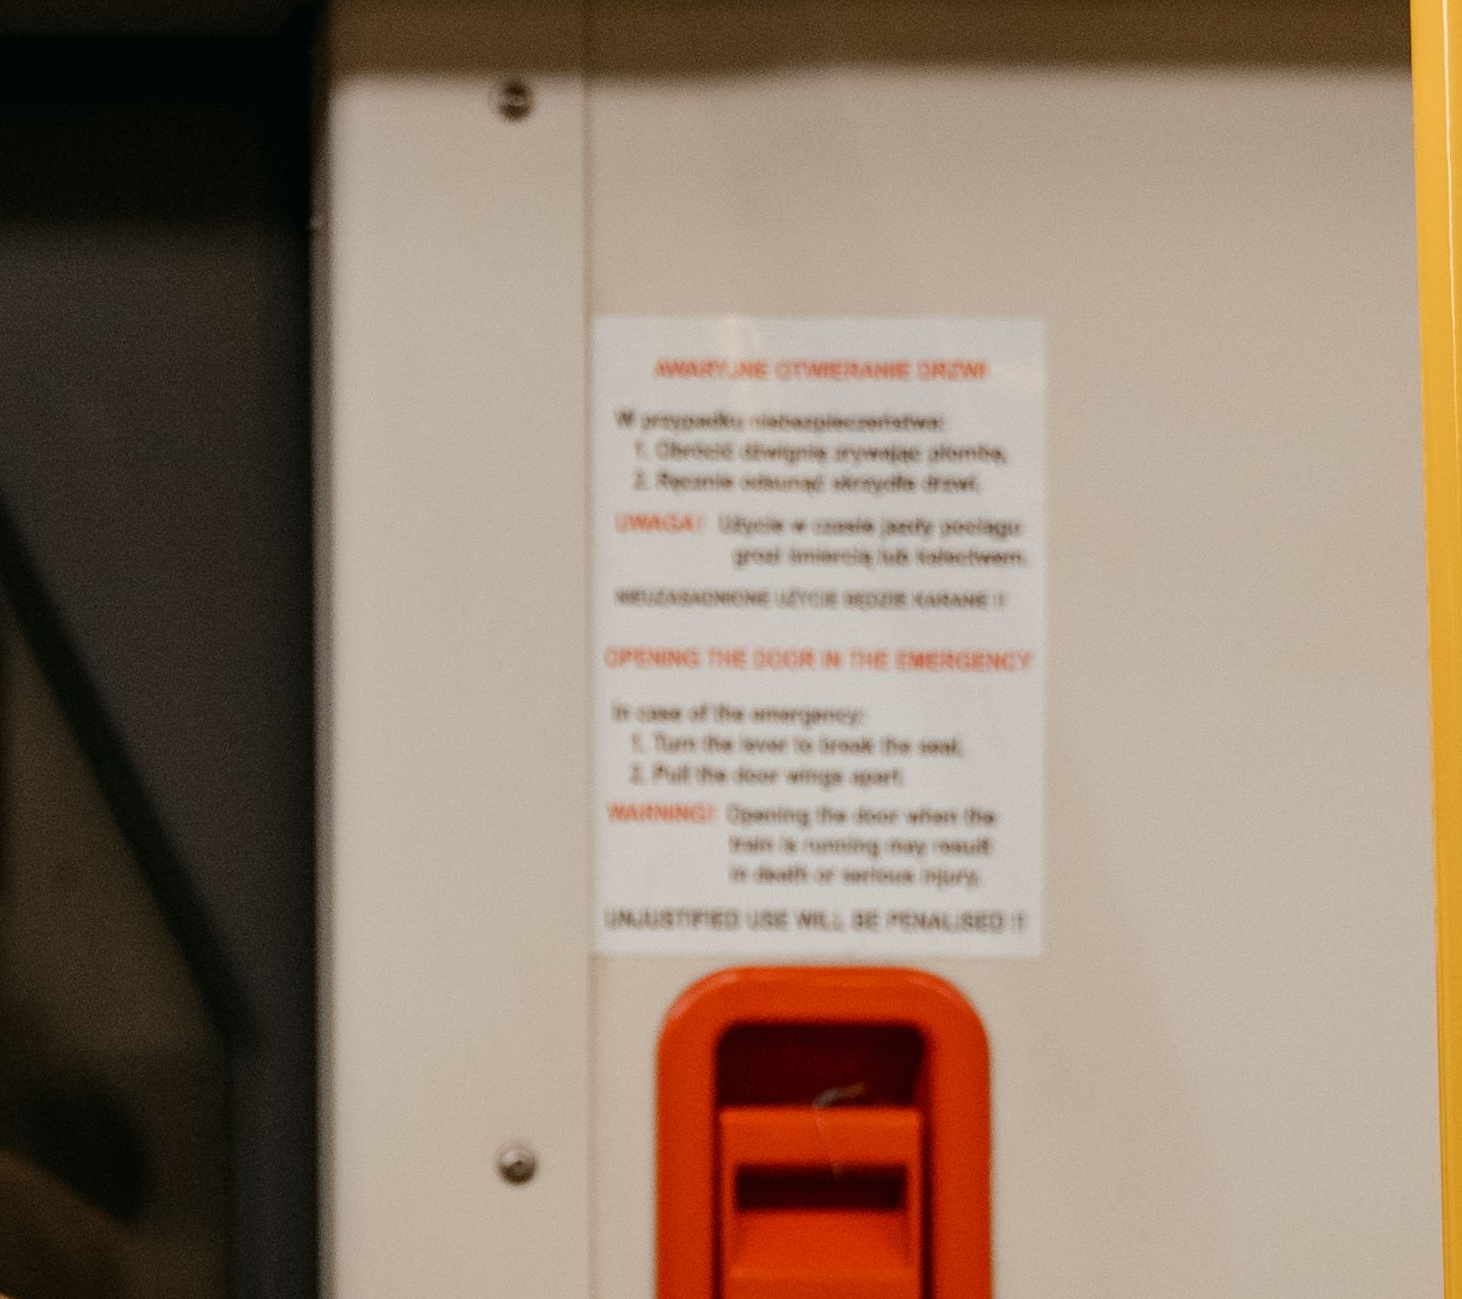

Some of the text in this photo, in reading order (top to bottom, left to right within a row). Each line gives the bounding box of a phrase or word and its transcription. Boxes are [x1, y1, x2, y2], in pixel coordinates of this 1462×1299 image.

[604, 646, 700, 670] OPENING
[754, 646, 814, 670] DOOR
[896, 647, 1031, 671] EMERGENCY
[653, 732, 696, 753] Turn
[608, 803, 716, 824] WARNING!
[604, 908, 738, 932] UNJUSTIFIED
[745, 908, 788, 932] USE
[797, 908, 846, 932] WILL
